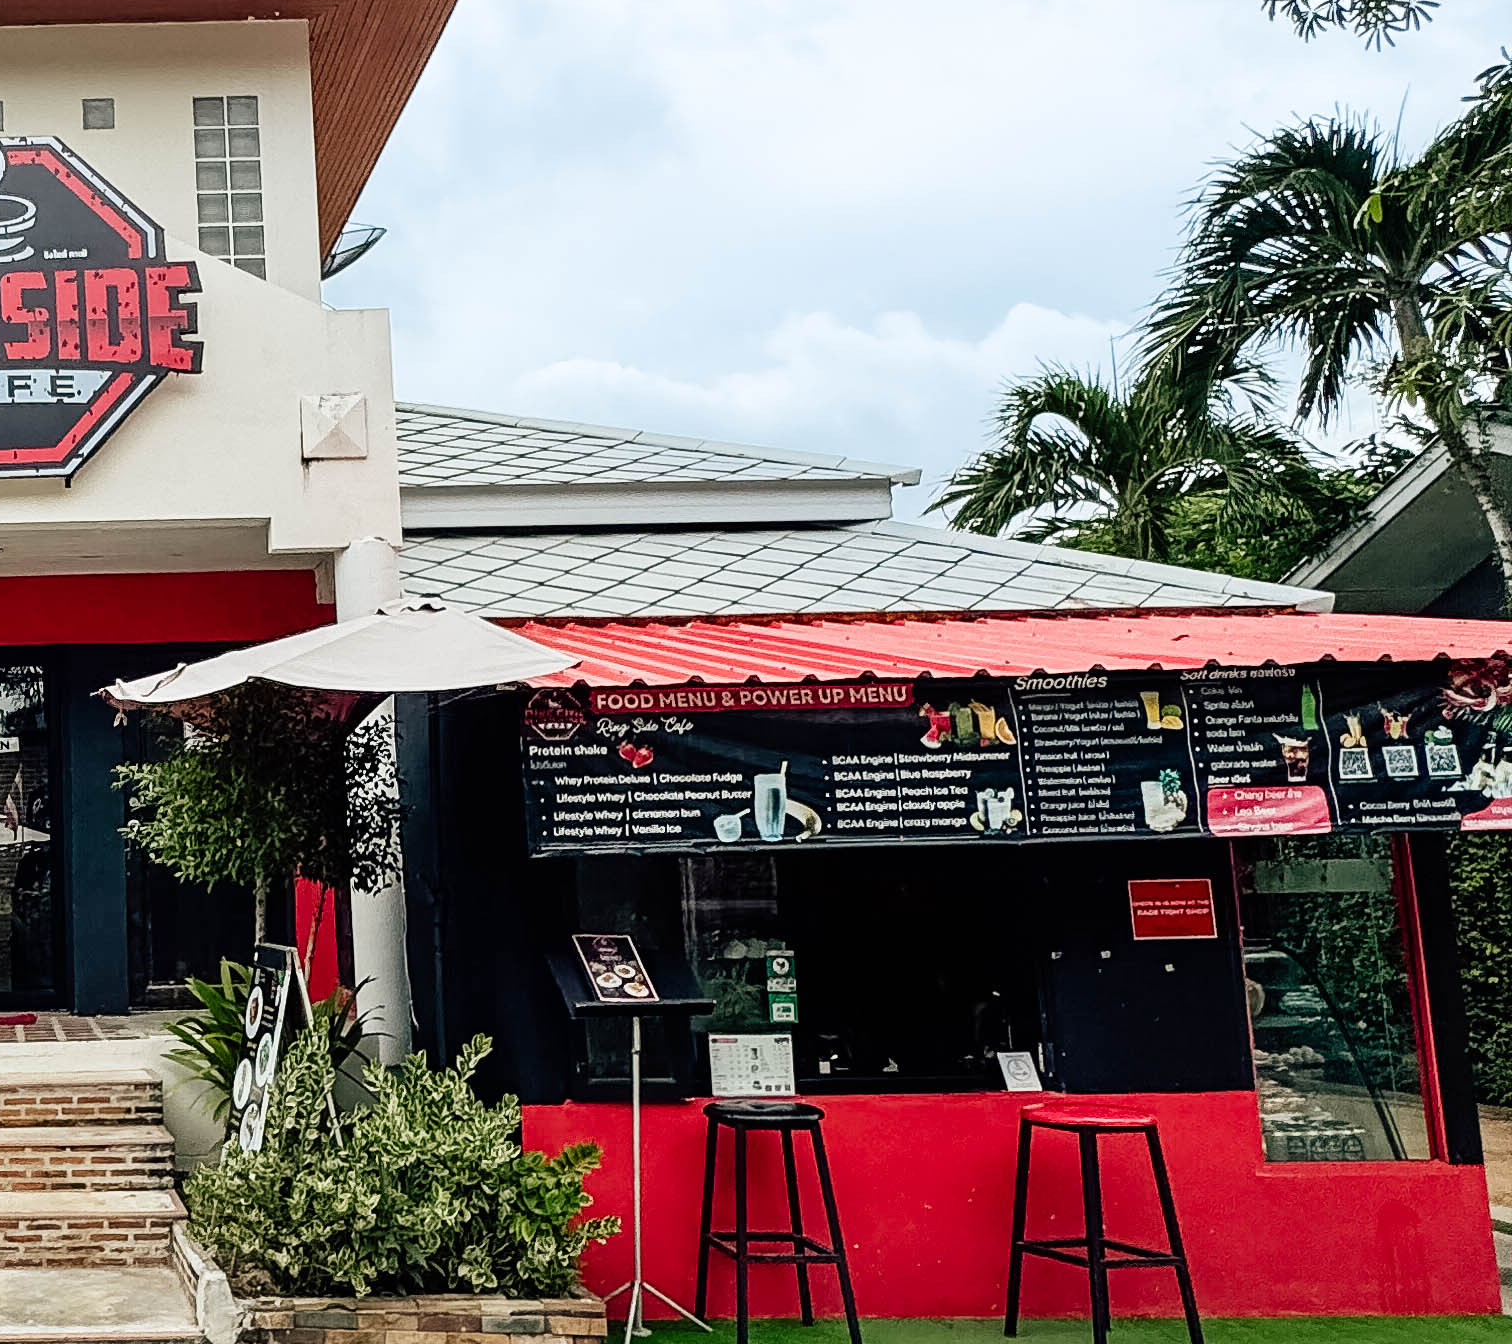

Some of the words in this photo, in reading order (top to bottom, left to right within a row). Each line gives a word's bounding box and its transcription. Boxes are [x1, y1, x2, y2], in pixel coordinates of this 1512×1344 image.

[1014, 675, 1108, 690] Smoothies
[596, 693, 654, 709] FOOD
[659, 691, 717, 708] MENU
[721, 691, 735, 706] &
[740, 688, 815, 705] POWER
[818, 688, 844, 704] UP
[848, 686, 907, 703] MENU
[596, 717, 630, 737] Ring
[661, 716, 695, 735] Cafe
[529, 745, 572, 756] Protein
[574, 744, 608, 755] shake
[555, 776, 583, 787] Whey
[584, 776, 618, 785] Protein
[659, 773, 712, 783] Chocolate
[712, 772, 743, 784] Fudge
[597, 793, 626, 803] Whey
[634, 791, 684, 801] Chocolate
[685, 790, 720, 800] Peanut
[902, 787, 932, 796] Peach
[949, 785, 969, 795] Tea
[594, 810, 623, 822] Whey
[594, 825, 623, 837] Whey
